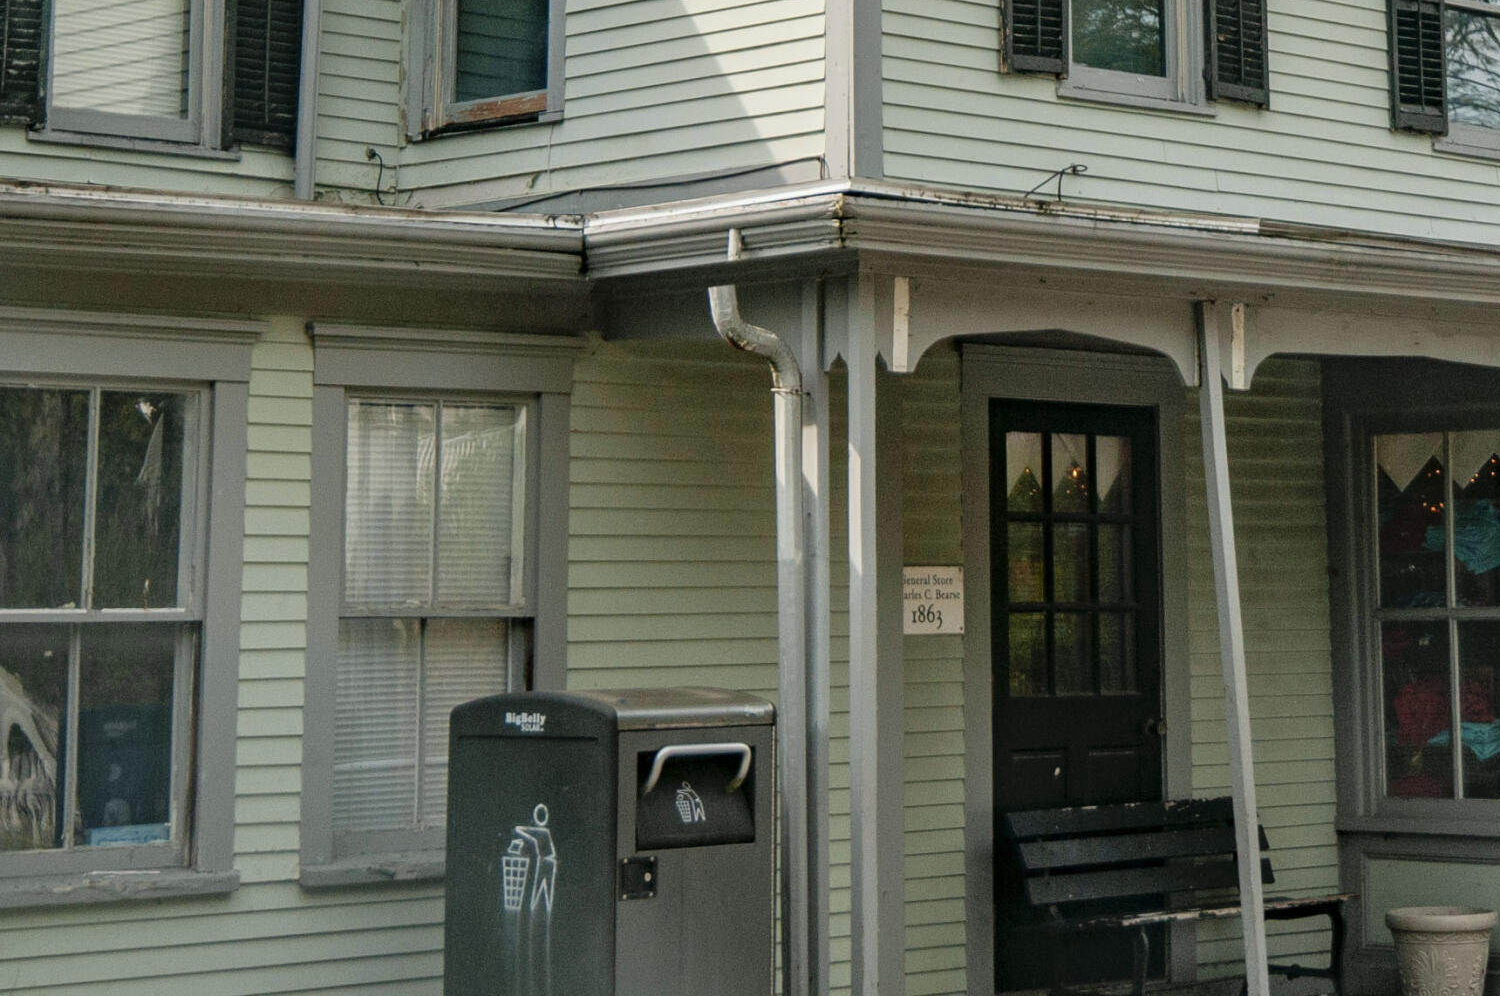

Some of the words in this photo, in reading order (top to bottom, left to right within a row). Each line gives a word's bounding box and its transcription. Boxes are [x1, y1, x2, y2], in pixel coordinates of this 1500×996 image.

[932, 574, 953, 585] Store
[935, 589, 961, 599] Bearse
[911, 604, 943, 629] 1863
[505, 712, 546, 726] BigBelly
